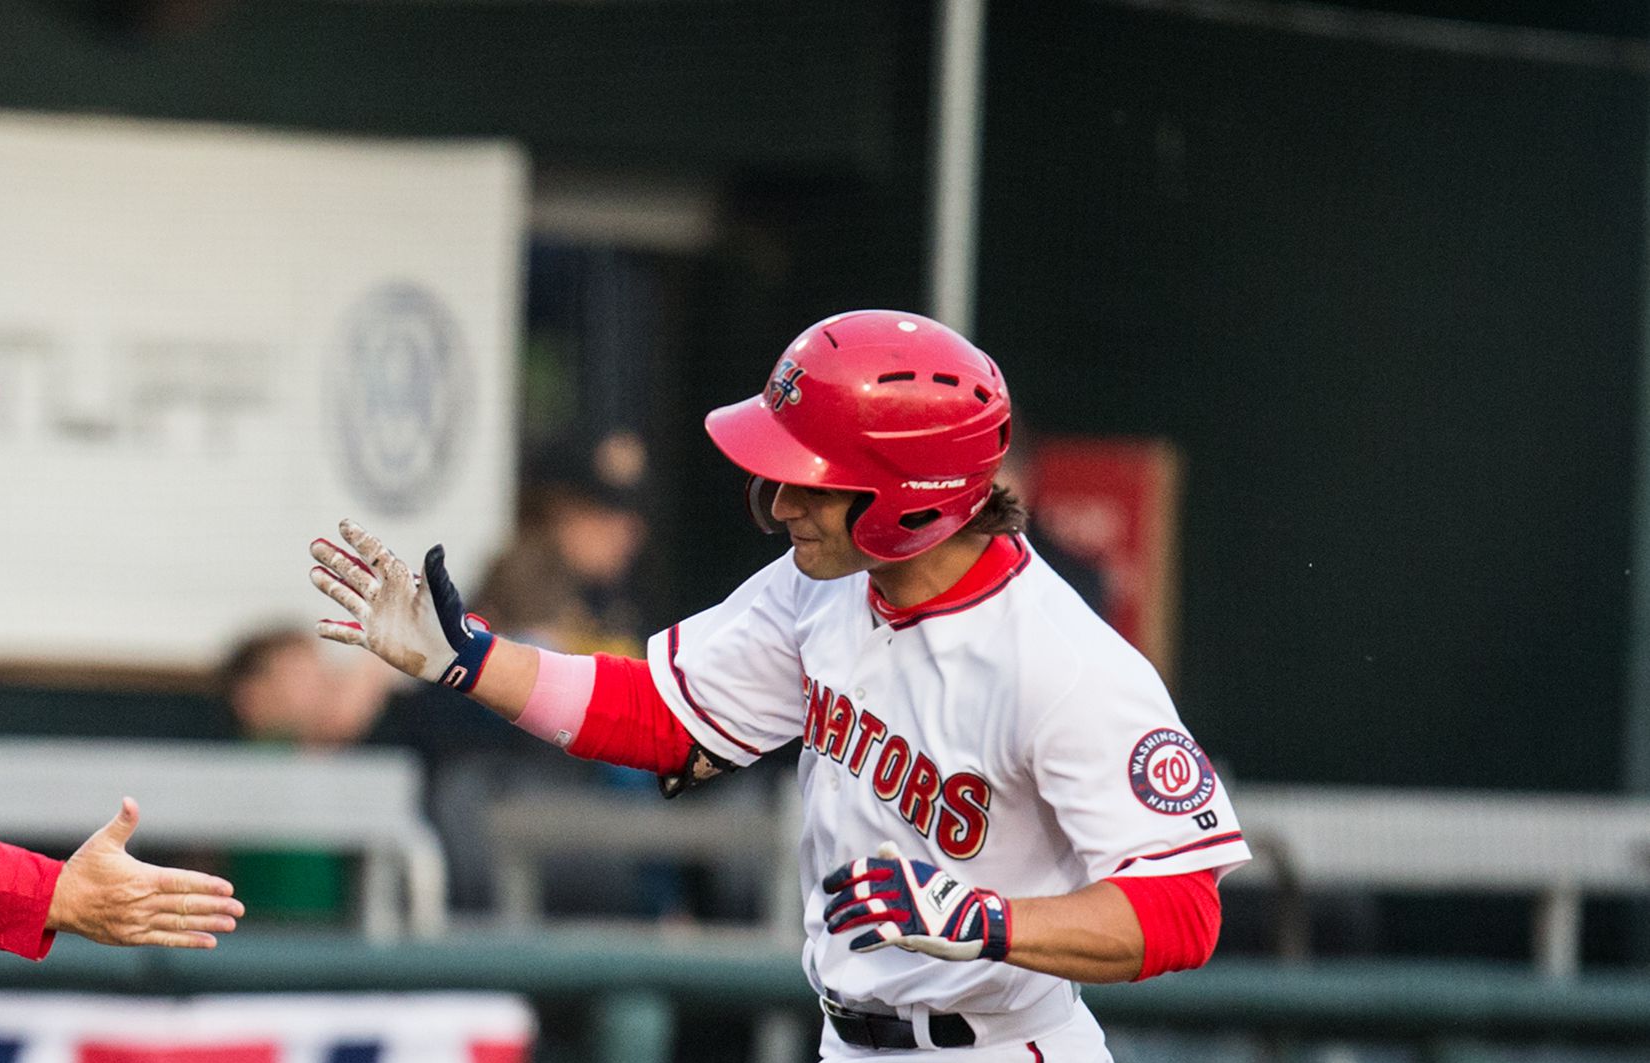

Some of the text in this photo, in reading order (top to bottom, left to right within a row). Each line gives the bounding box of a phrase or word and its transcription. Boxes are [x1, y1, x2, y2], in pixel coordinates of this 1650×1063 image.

[802, 671, 991, 861] NATORS
[1131, 731, 1202, 776] WASHINGTON
[1152, 749, 1191, 793] W
[1146, 777, 1213, 812] NATIONALS
